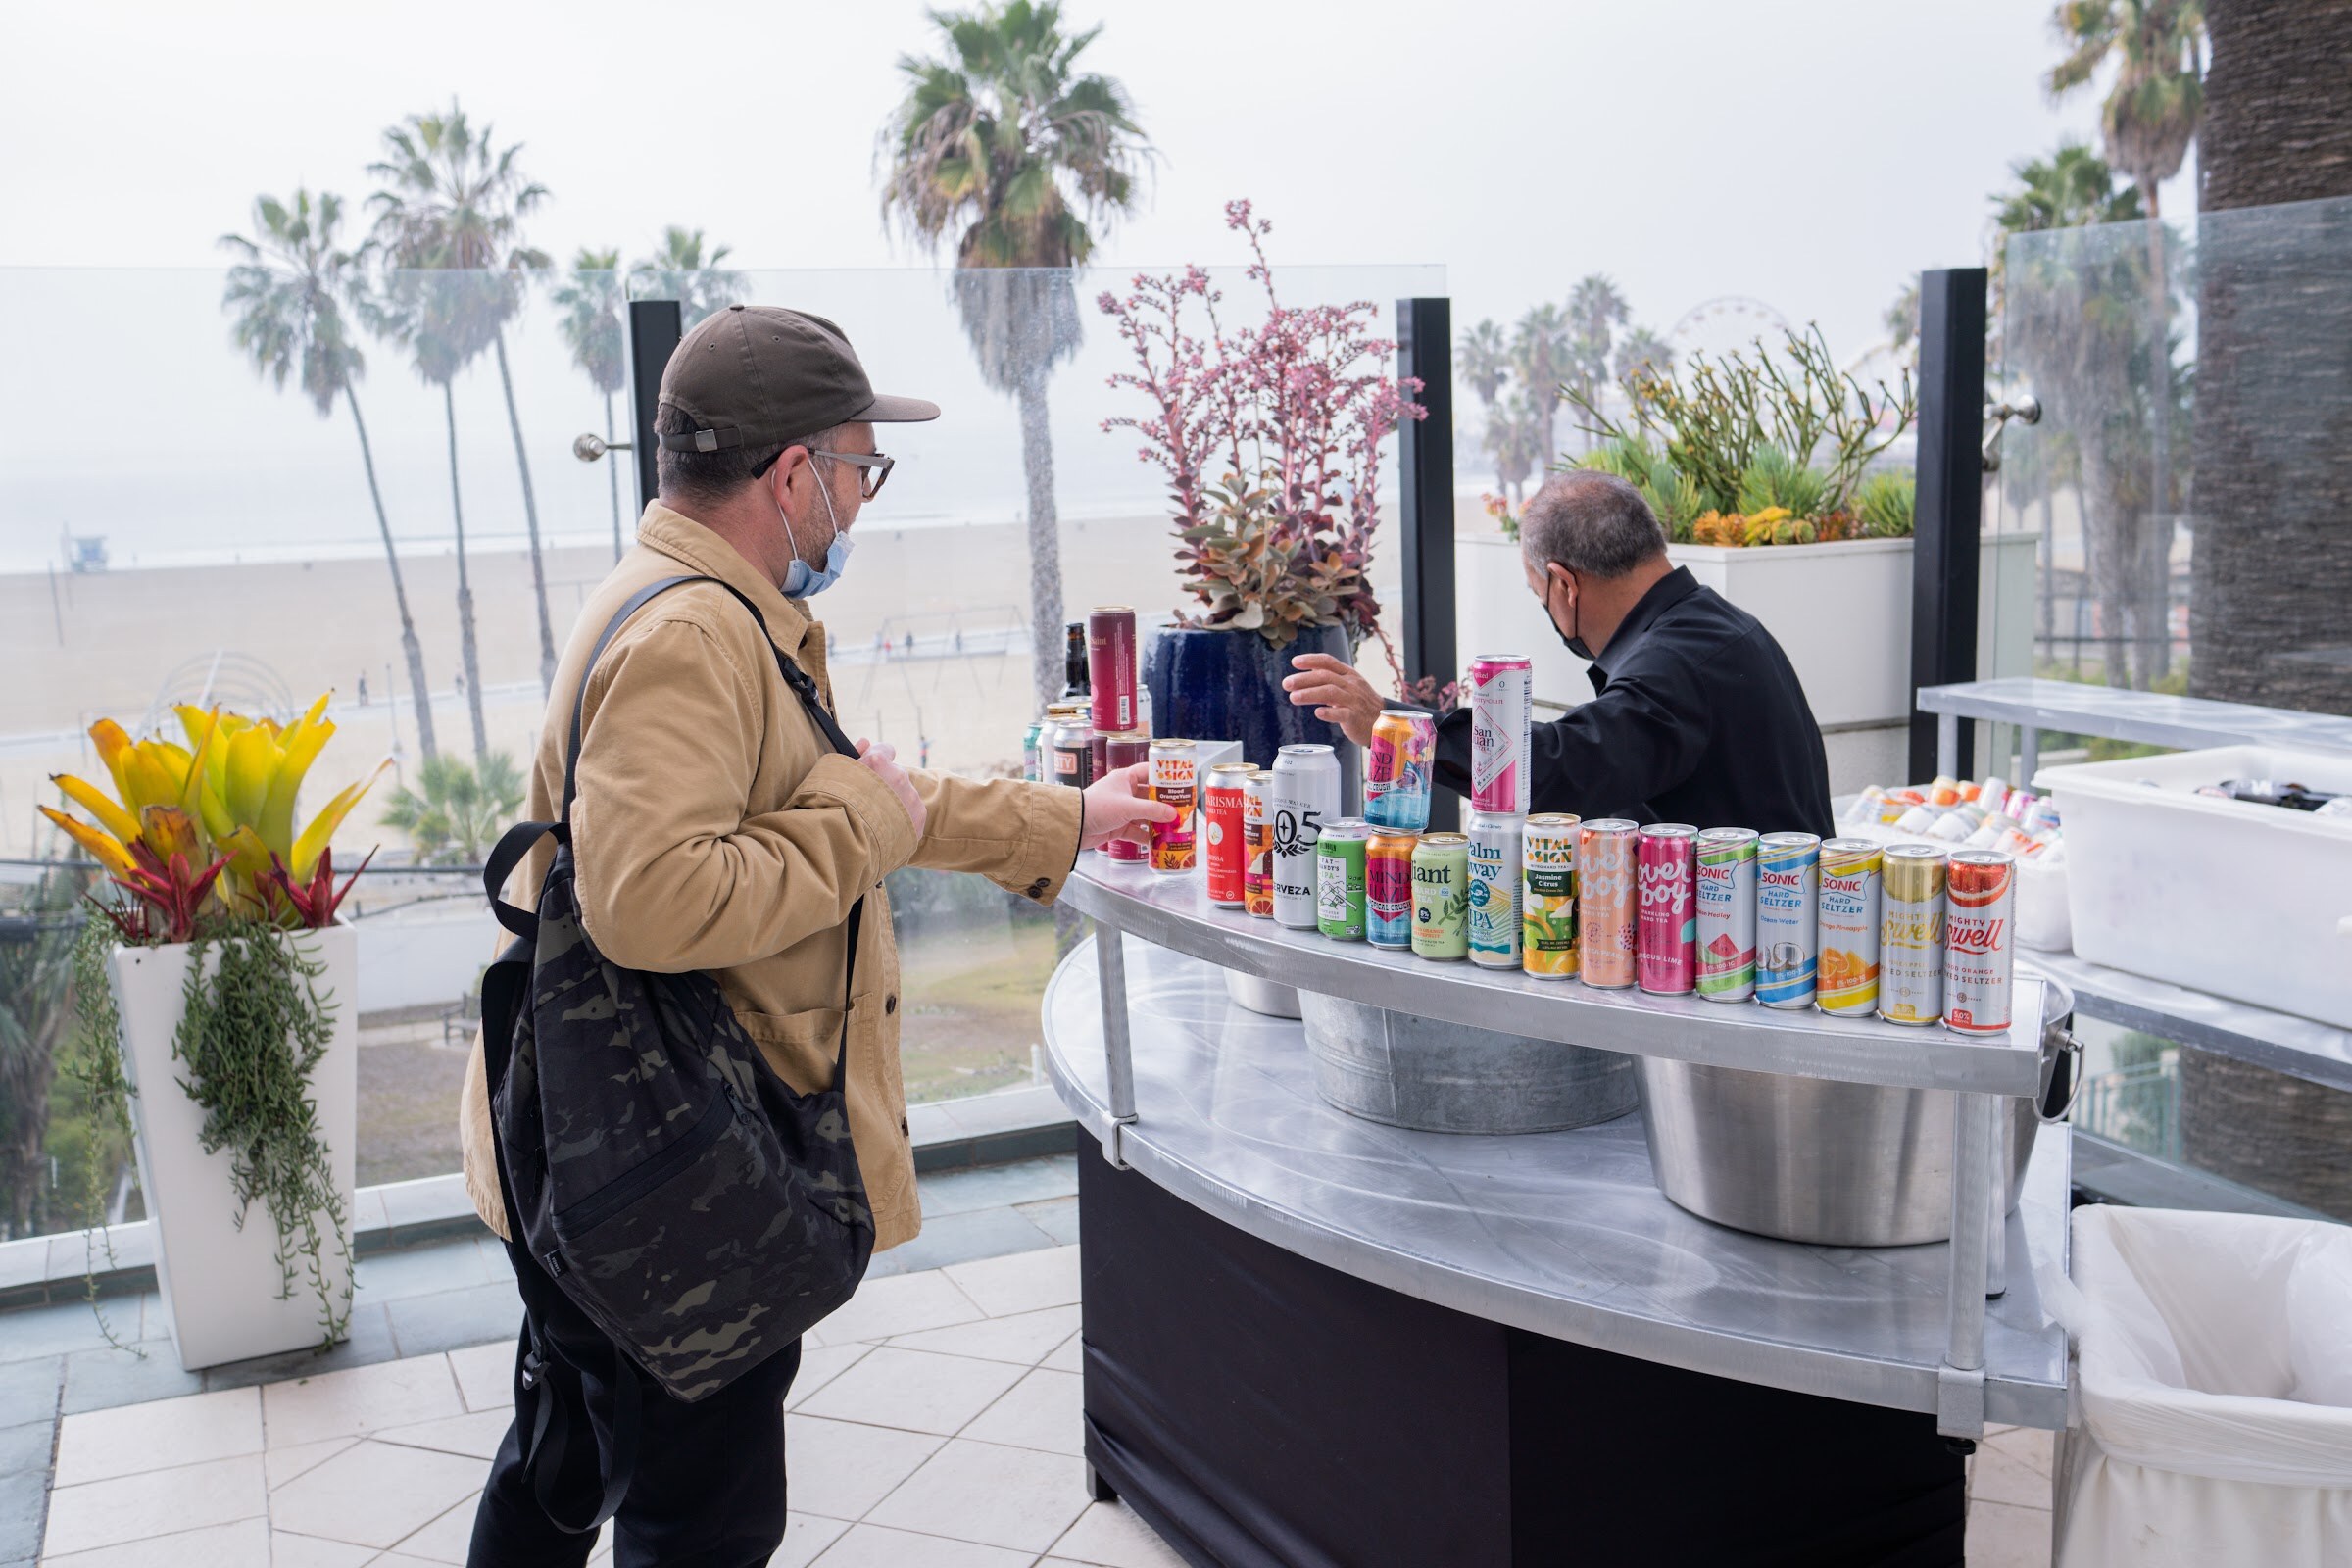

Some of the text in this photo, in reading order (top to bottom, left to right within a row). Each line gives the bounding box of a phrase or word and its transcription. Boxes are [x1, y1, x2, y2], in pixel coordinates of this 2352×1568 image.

[1468, 861, 1503, 881] way
[1638, 858, 1691, 883] over
[1535, 873, 1562, 882] Jasmine
[1761, 872, 1800, 886] SONIC
[1823, 877, 1862, 892] SONIC
[1638, 881, 1691, 914] boy
[1768, 890, 1790, 899] HARD
[1829, 896, 1851, 905] HARD
[1760, 896, 1802, 907] SELTZER
[1821, 902, 1864, 914] SELTZER
[1760, 915, 1778, 924] Ocean
[1948, 914, 1986, 926] MIGHTY
[1881, 911, 1944, 947] Swell
[1944, 918, 2005, 952] Swell
[1663, 956, 1682, 966] LIME
[1961, 975, 2003, 985] SELTZER
